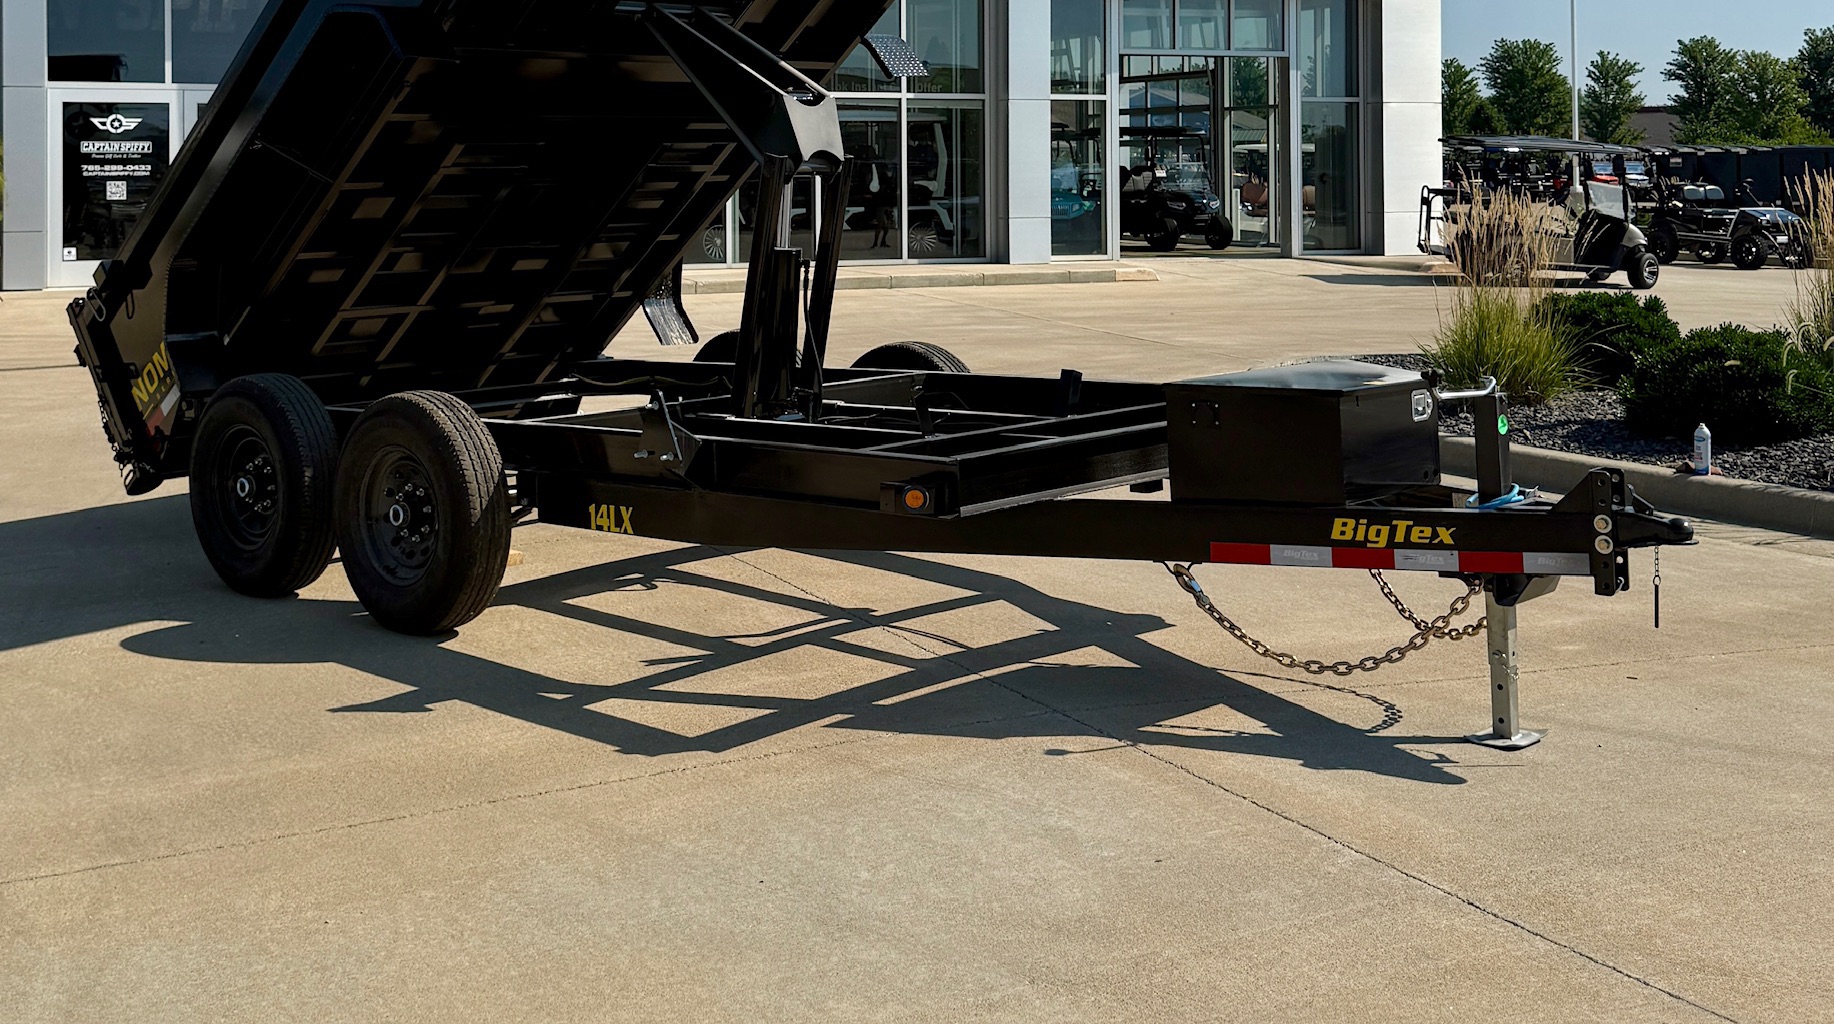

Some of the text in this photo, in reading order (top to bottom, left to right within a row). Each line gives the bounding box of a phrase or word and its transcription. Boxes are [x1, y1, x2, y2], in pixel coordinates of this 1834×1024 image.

[83, 142, 150, 152] CAPTAIN SPIFFY
[588, 502, 635, 535] 14LX
[1331, 517, 1457, 548] BigTex
